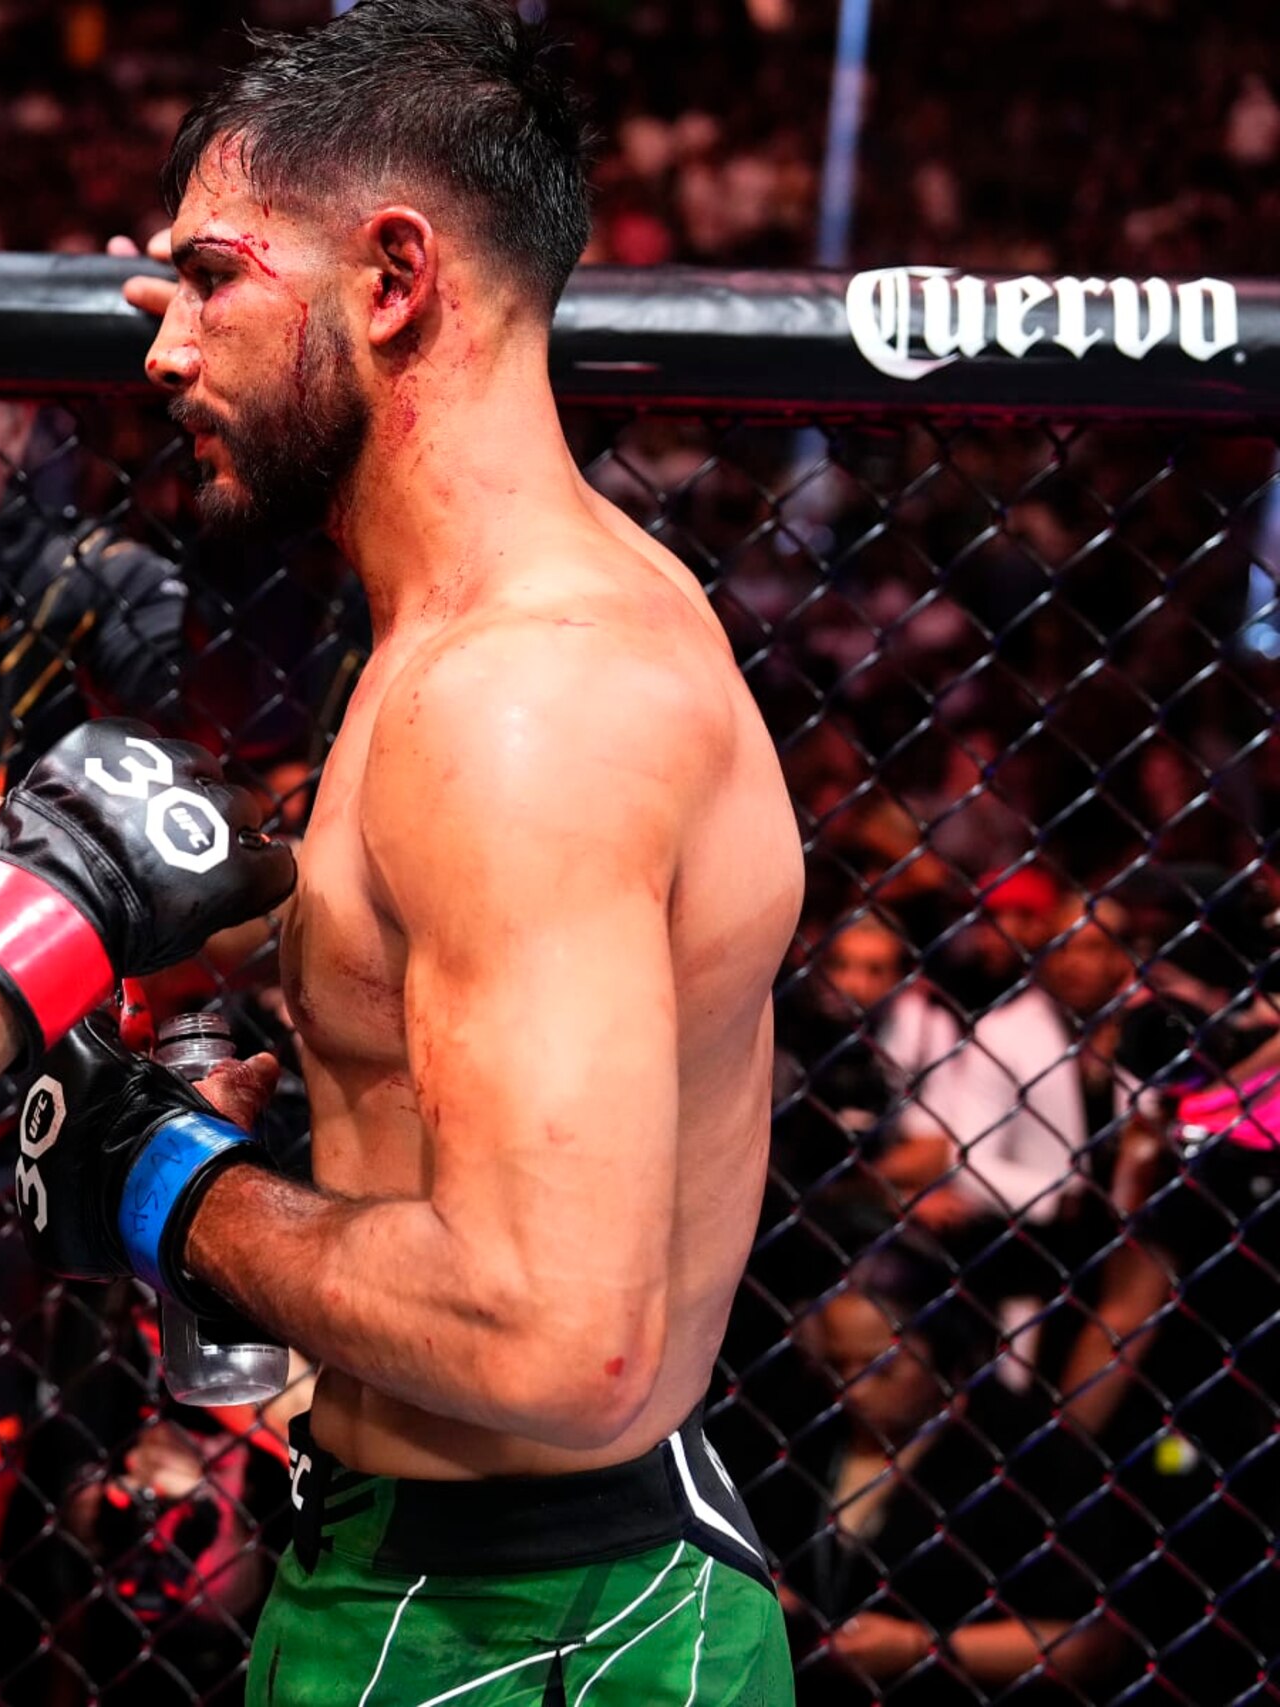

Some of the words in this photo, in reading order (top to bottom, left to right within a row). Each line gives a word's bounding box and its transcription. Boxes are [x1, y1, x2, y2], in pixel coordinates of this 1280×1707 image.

[846, 266, 1239, 380] Cuervo
[169, 807, 211, 849] UFC
[29, 1093, 48, 1138] UFC
